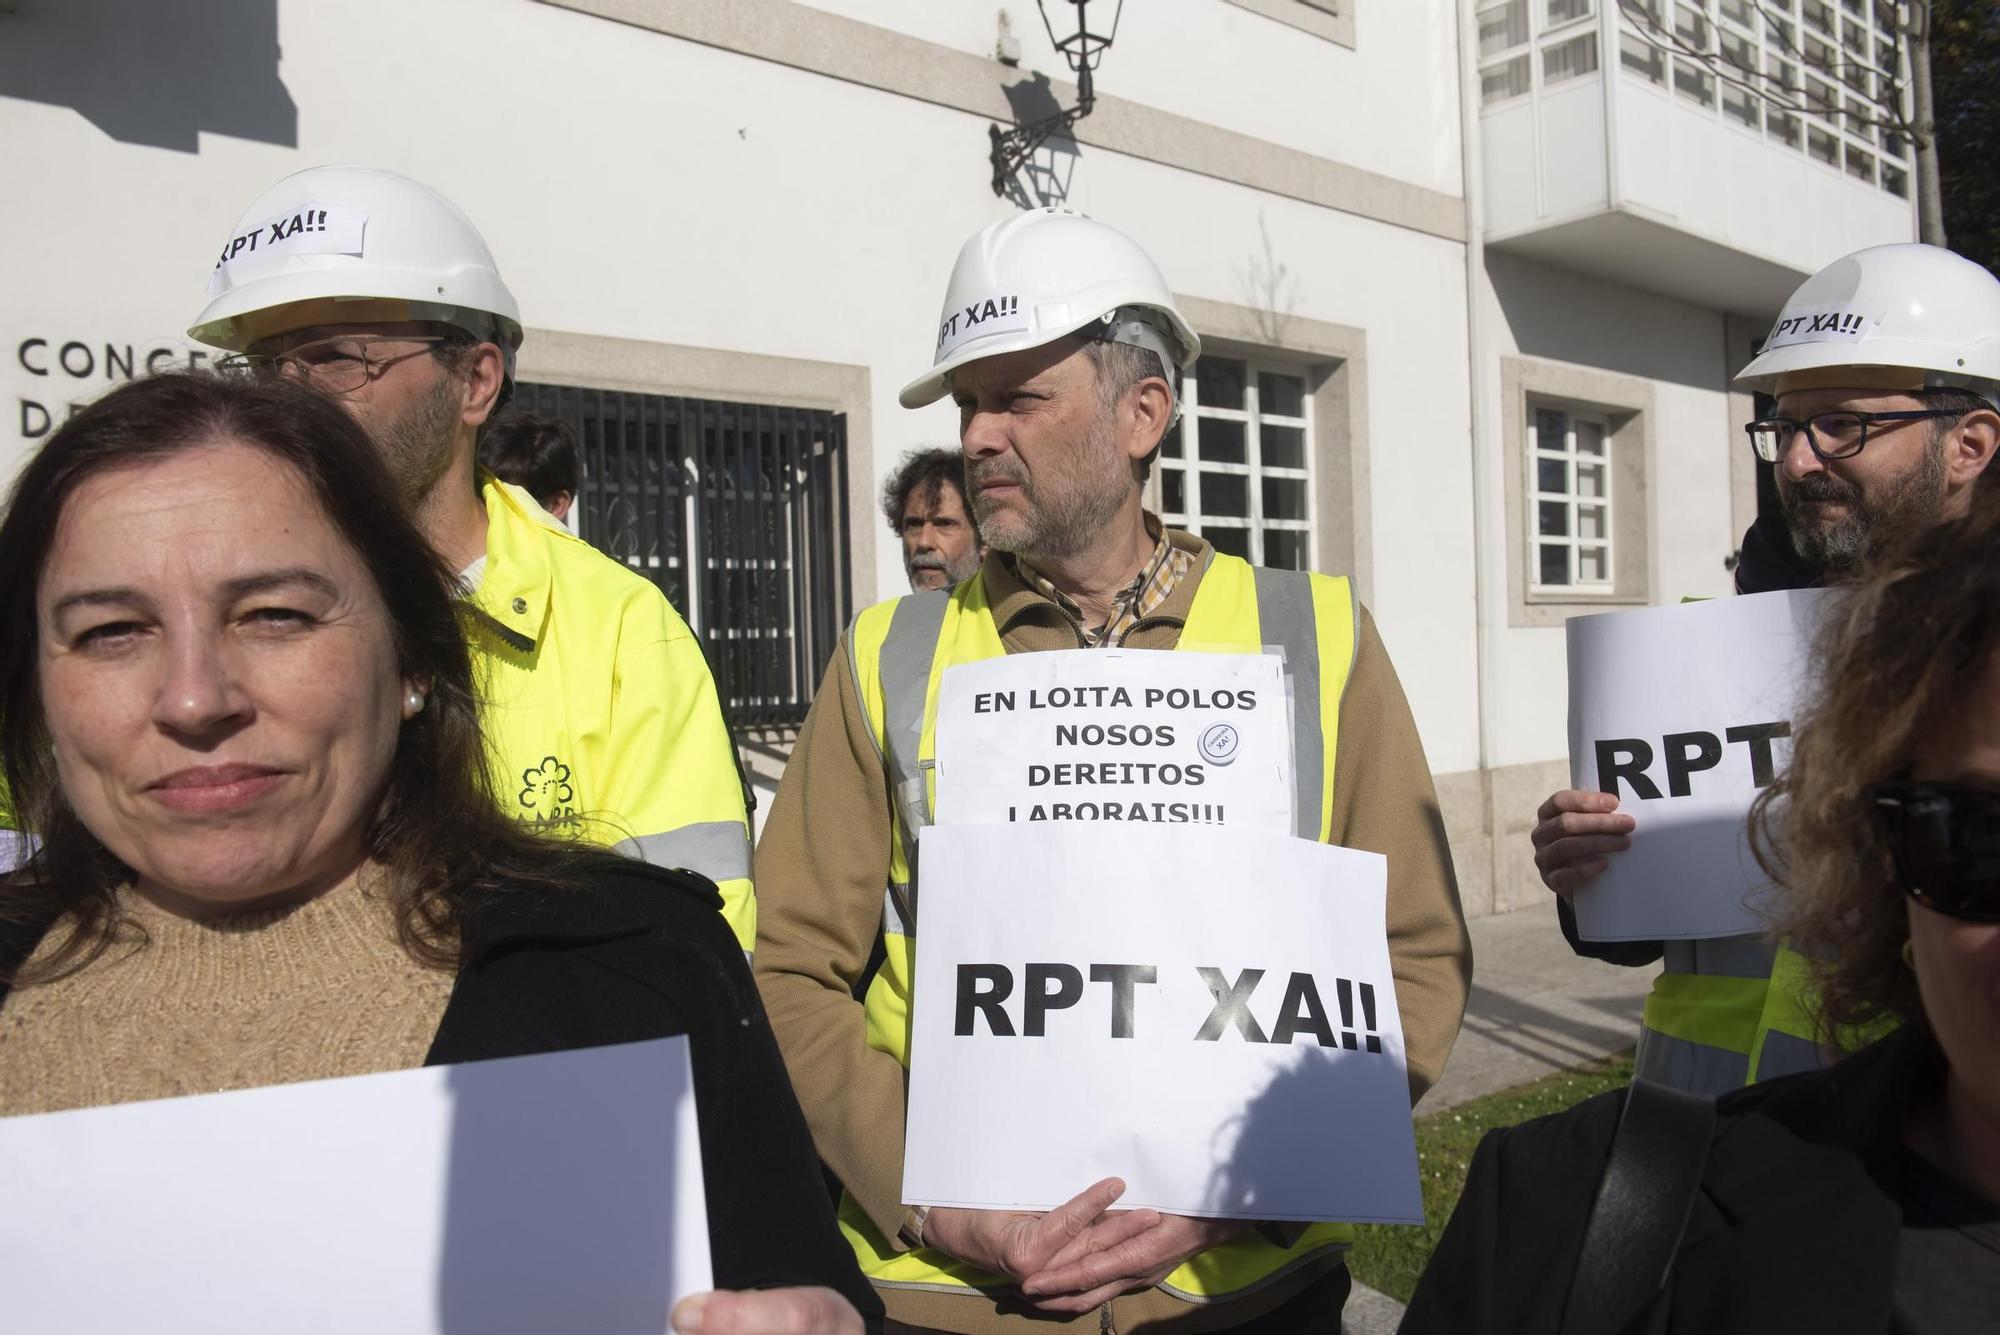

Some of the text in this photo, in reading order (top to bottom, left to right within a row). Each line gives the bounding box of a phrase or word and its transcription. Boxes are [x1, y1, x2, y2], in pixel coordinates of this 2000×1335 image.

[268, 209, 328, 245] XA!!
[937, 295, 1018, 350] PT XA!!
[1771, 312, 1863, 340] PT XA!!
[974, 686, 1257, 714] EN LOITA POLOS
[1056, 724, 1176, 747] NOSOS
[1028, 762, 1206, 787] DEREITOS
[1594, 720, 1792, 801] RPT
[954, 963, 1382, 1054] RPT XA!!
